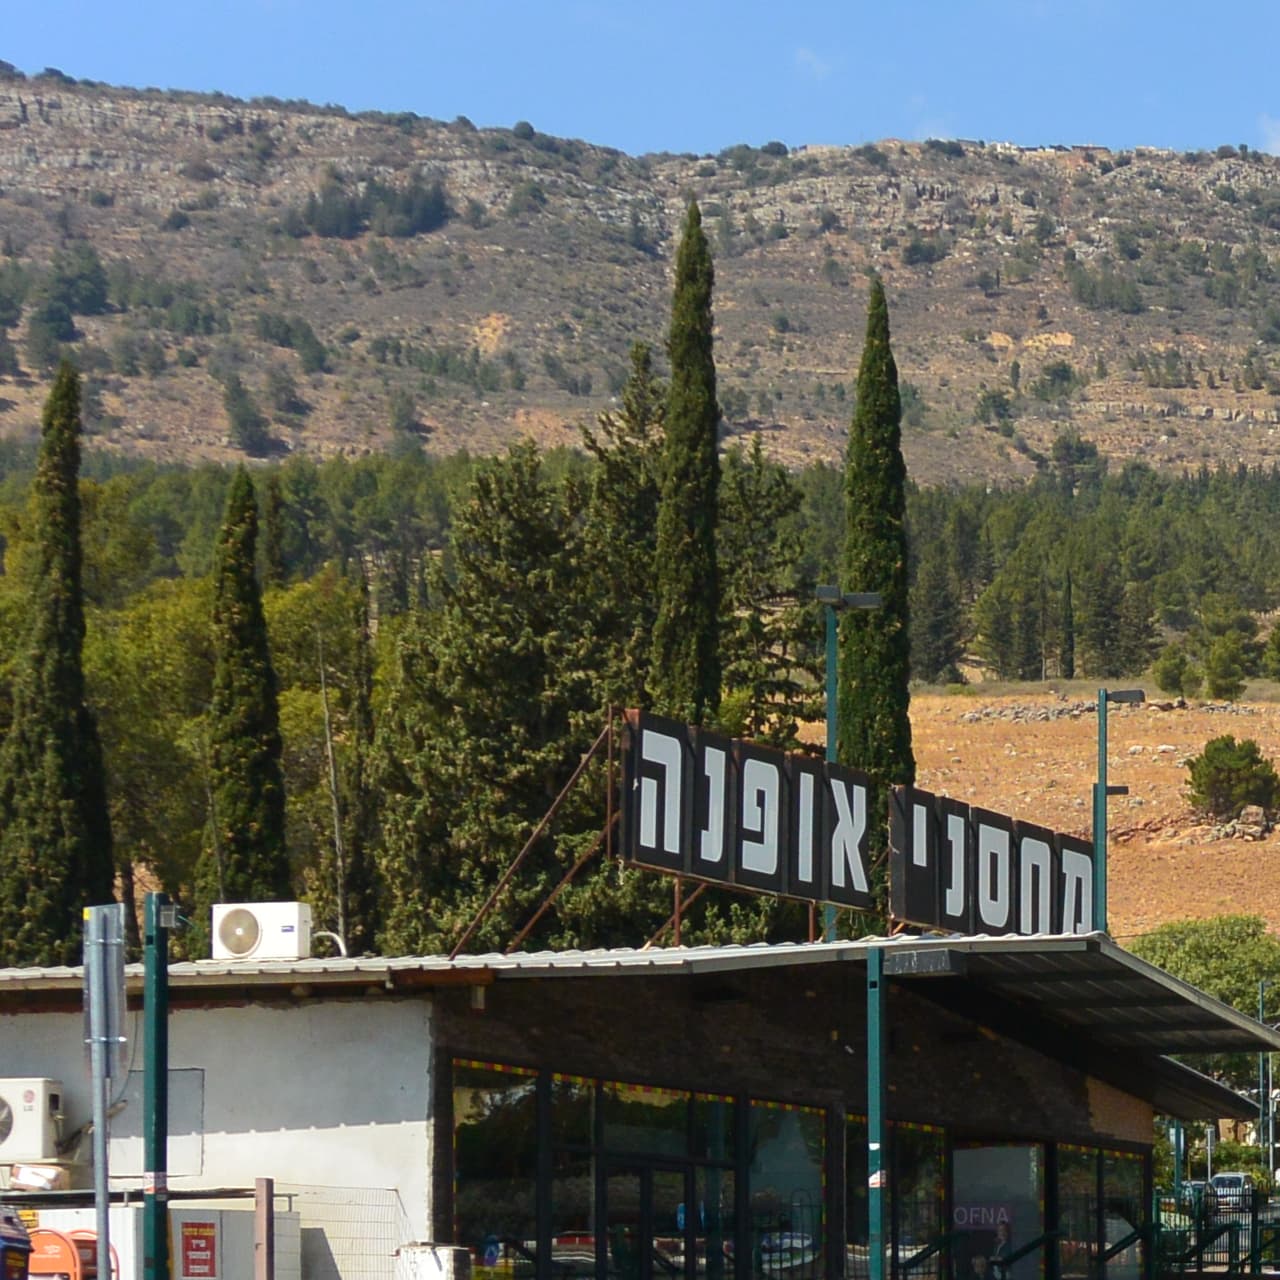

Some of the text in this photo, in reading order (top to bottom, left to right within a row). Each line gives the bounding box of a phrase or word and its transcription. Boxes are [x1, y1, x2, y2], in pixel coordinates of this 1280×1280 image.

[640, 729, 1093, 934] מחסני אופנה
[953, 1207, 1009, 1225] OFNA
